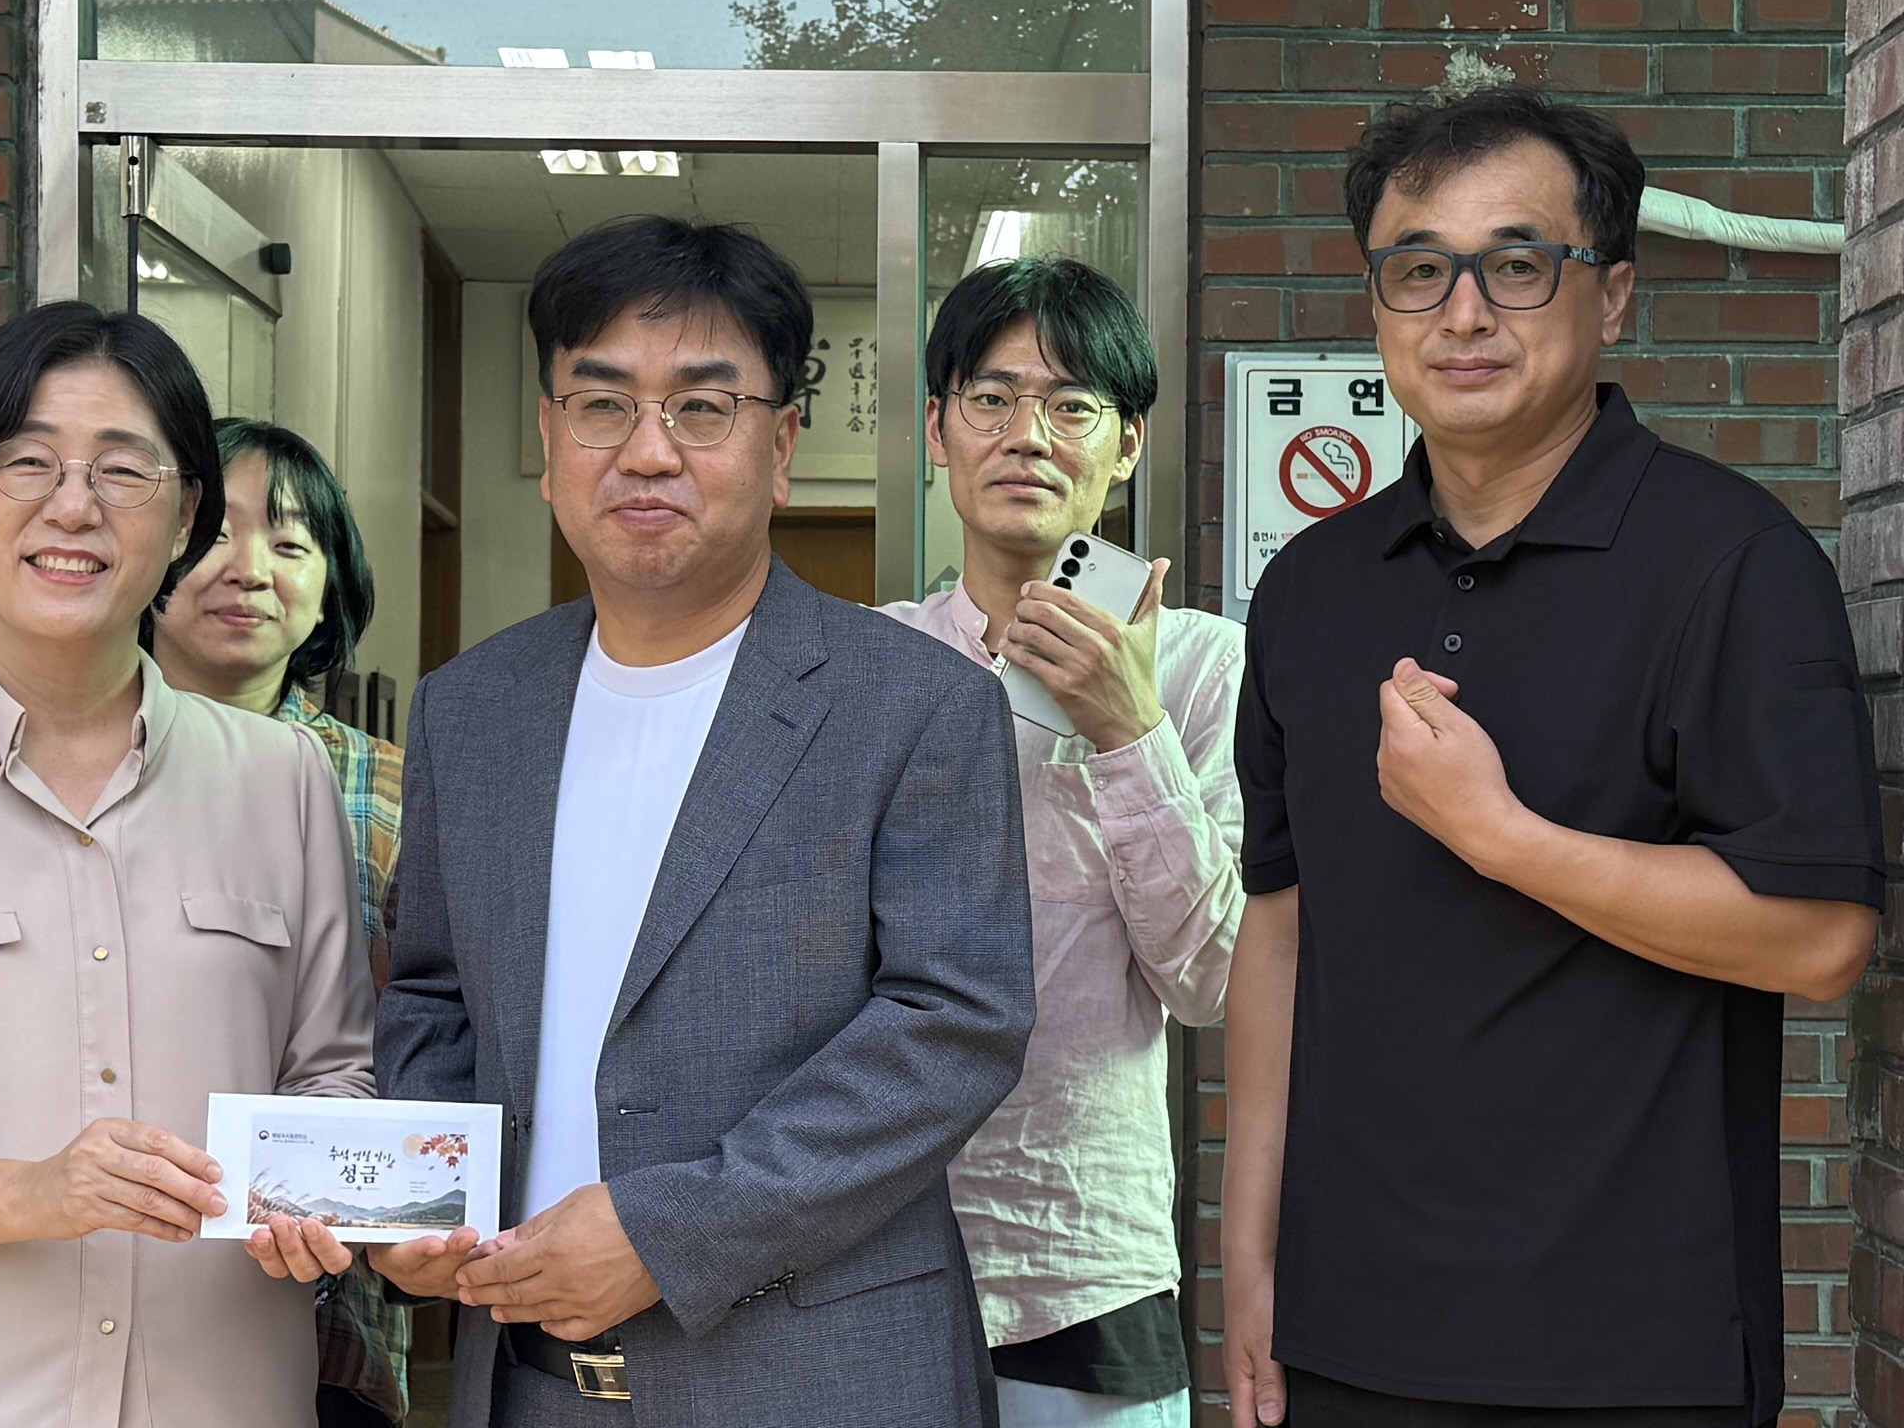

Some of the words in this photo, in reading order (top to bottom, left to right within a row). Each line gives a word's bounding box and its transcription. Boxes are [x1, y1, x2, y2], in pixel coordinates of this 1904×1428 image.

[1299, 432, 1313, 442] NO
[1315, 428, 1353, 444] SMOKING
[339, 1164, 379, 1184] 성금
